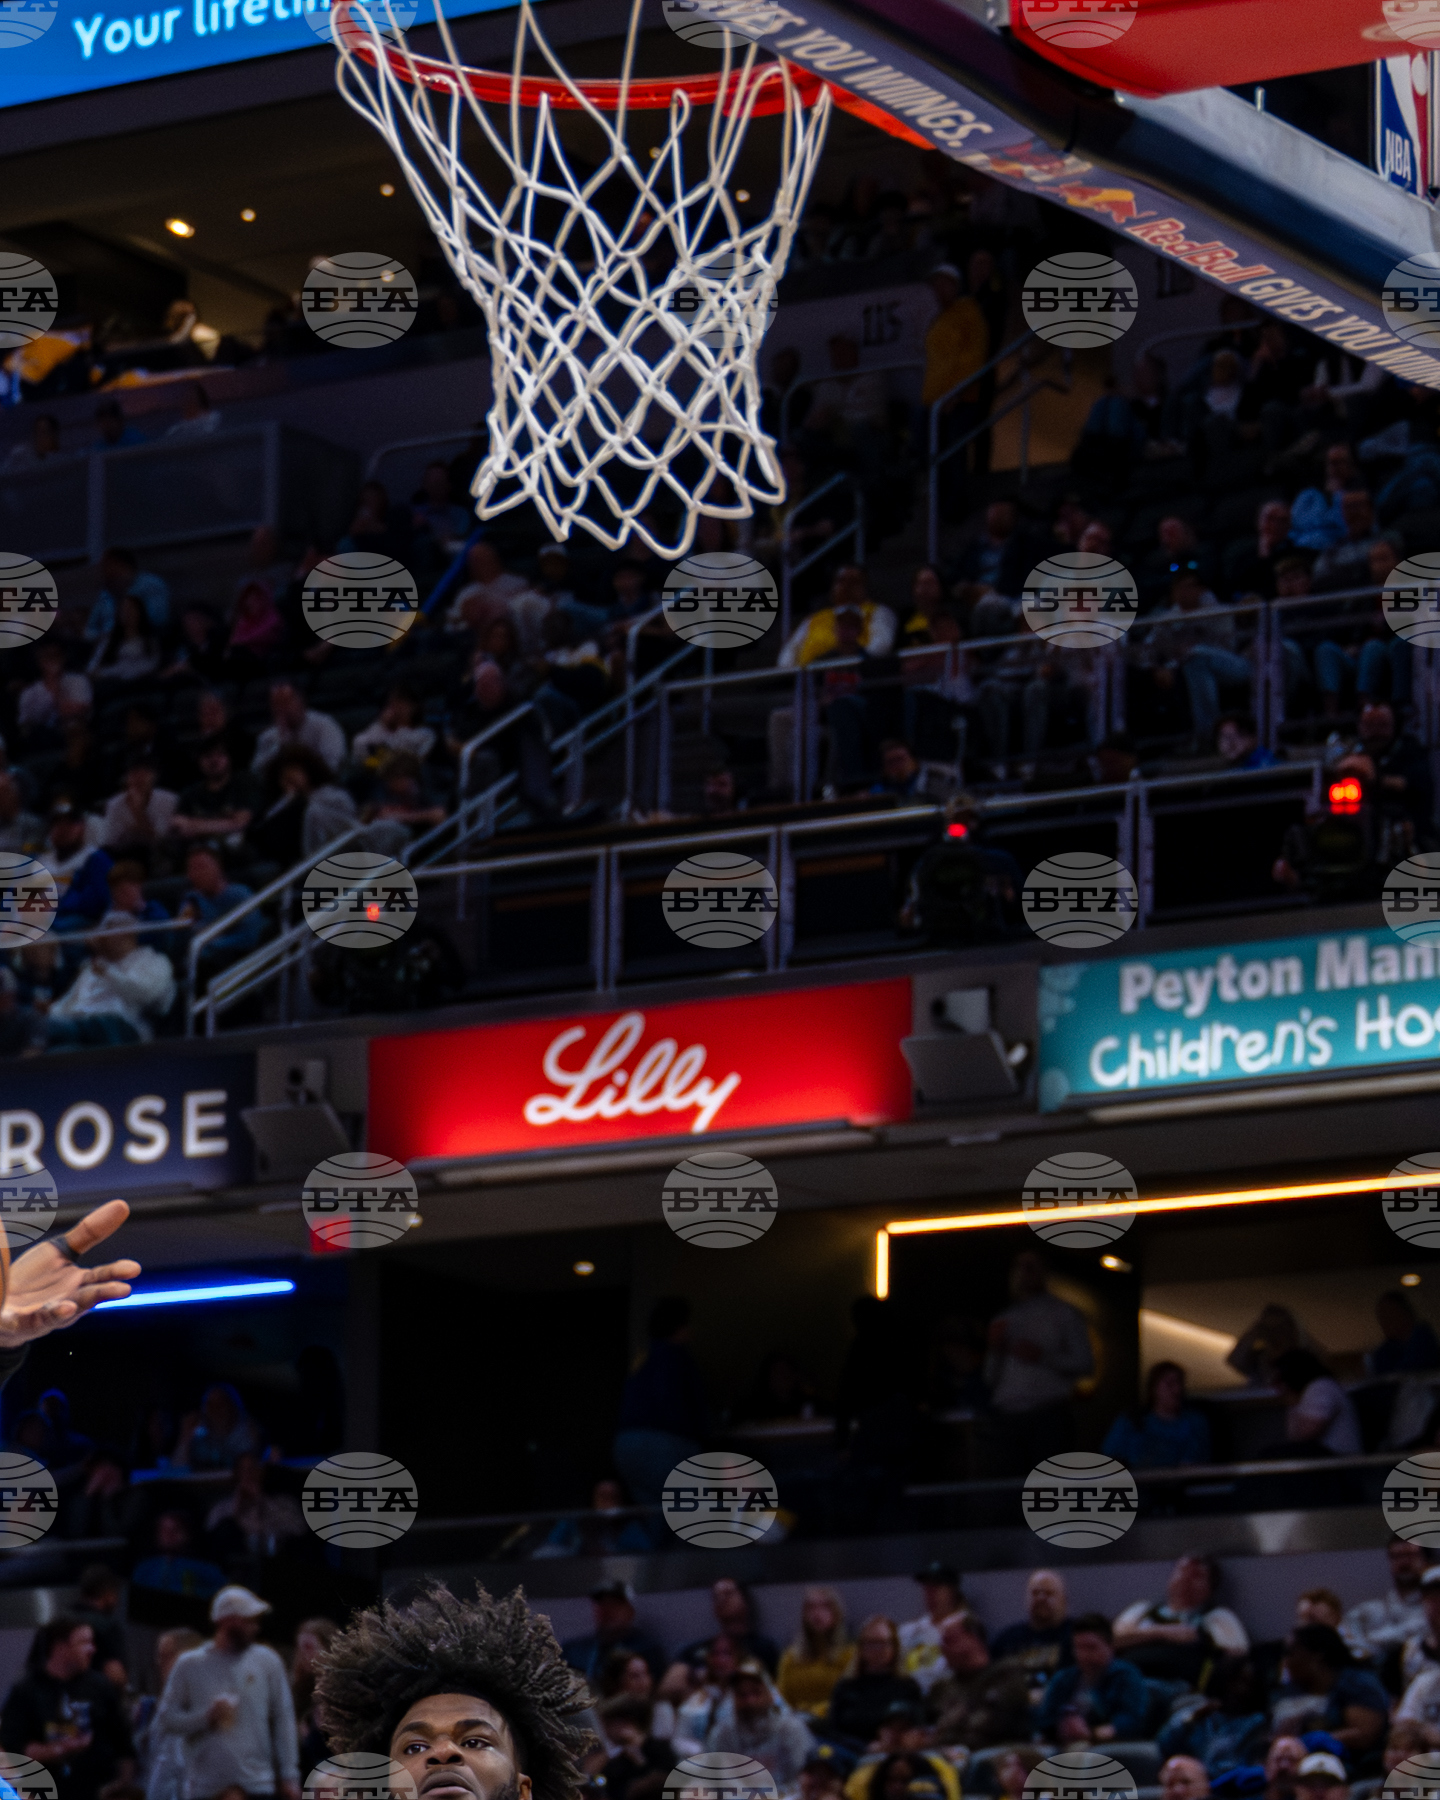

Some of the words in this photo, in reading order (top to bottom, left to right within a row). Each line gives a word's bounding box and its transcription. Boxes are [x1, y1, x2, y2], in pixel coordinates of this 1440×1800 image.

[72, 8, 182, 60] Your
[775, 27, 879, 71] YOU
[1385, 128, 1412, 182] NBA
[1238, 277, 1347, 322] GIVES
[1312, 314, 1402, 350] YOU
[1119, 953, 1304, 1018] Peyton
[523, 1011, 742, 1134] Lilly
[1089, 1007, 1338, 1089] Children's
[1354, 993, 1440, 1052] Ho
